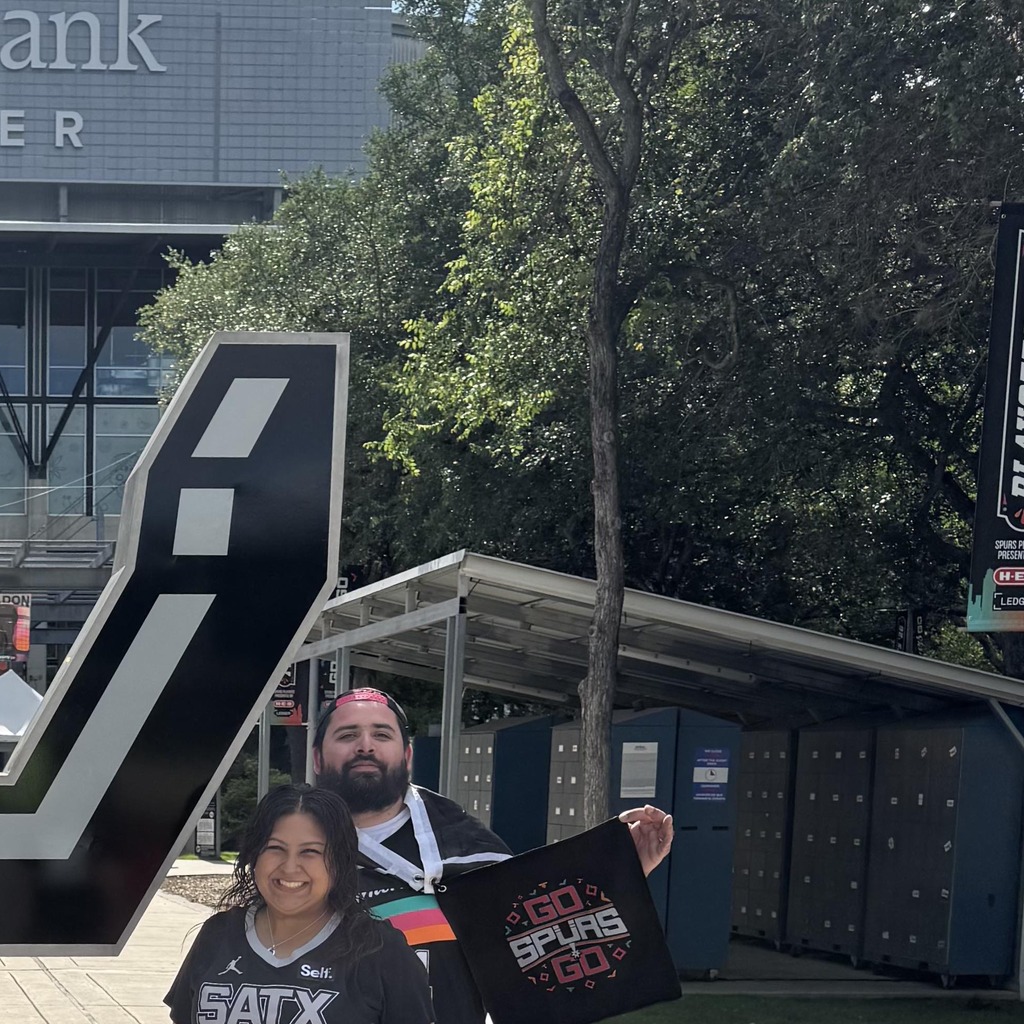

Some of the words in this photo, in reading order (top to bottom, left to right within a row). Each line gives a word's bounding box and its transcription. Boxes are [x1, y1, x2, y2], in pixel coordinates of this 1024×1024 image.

[994, 540, 1017, 549] SPURS
[523, 885, 584, 925] GO
[509, 908, 628, 968] SPURS
[551, 946, 610, 984] GO
